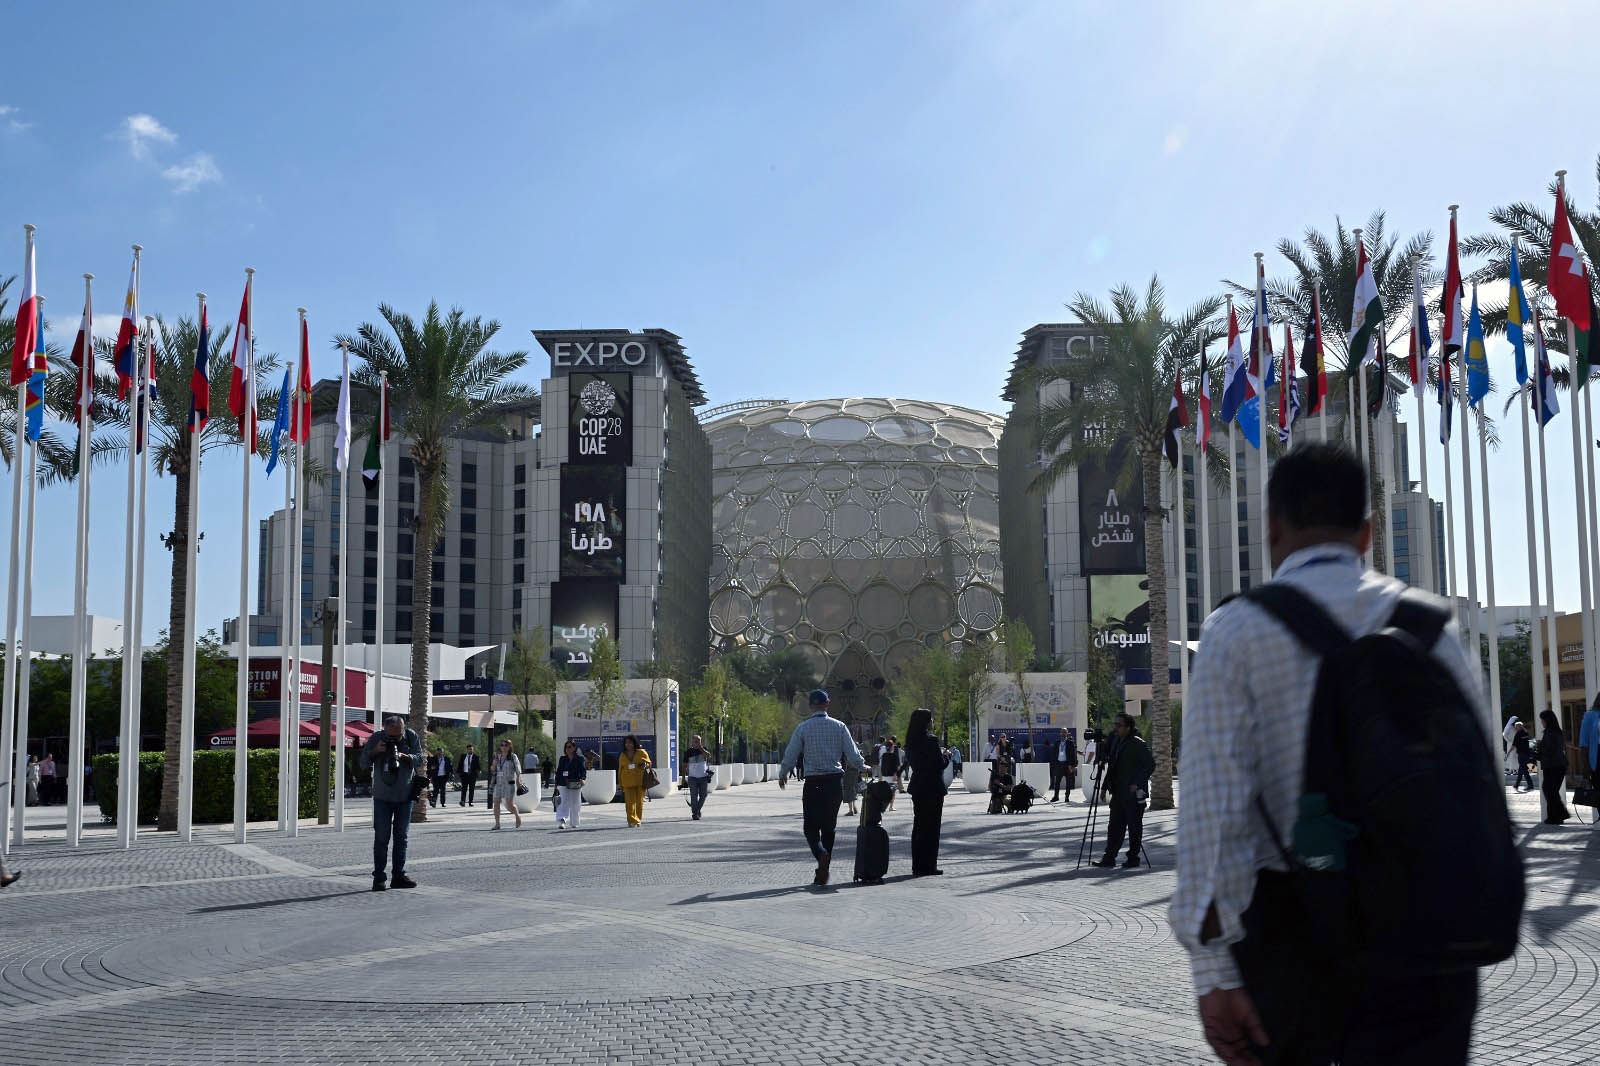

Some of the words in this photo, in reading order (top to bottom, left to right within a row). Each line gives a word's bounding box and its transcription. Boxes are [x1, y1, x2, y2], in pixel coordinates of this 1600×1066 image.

[554, 341, 646, 366] EXPO
[579, 418, 622, 436] COP28
[579, 437, 607, 455] UAE
[1106, 489, 1119, 506] ٨
[575, 503, 606, 522] ١٩٨
[1097, 511, 1130, 529] مليار
[1092, 528, 1134, 547] شخص
[1094, 626, 1152, 648] أسبوعان
[248, 670, 279, 681] STION
